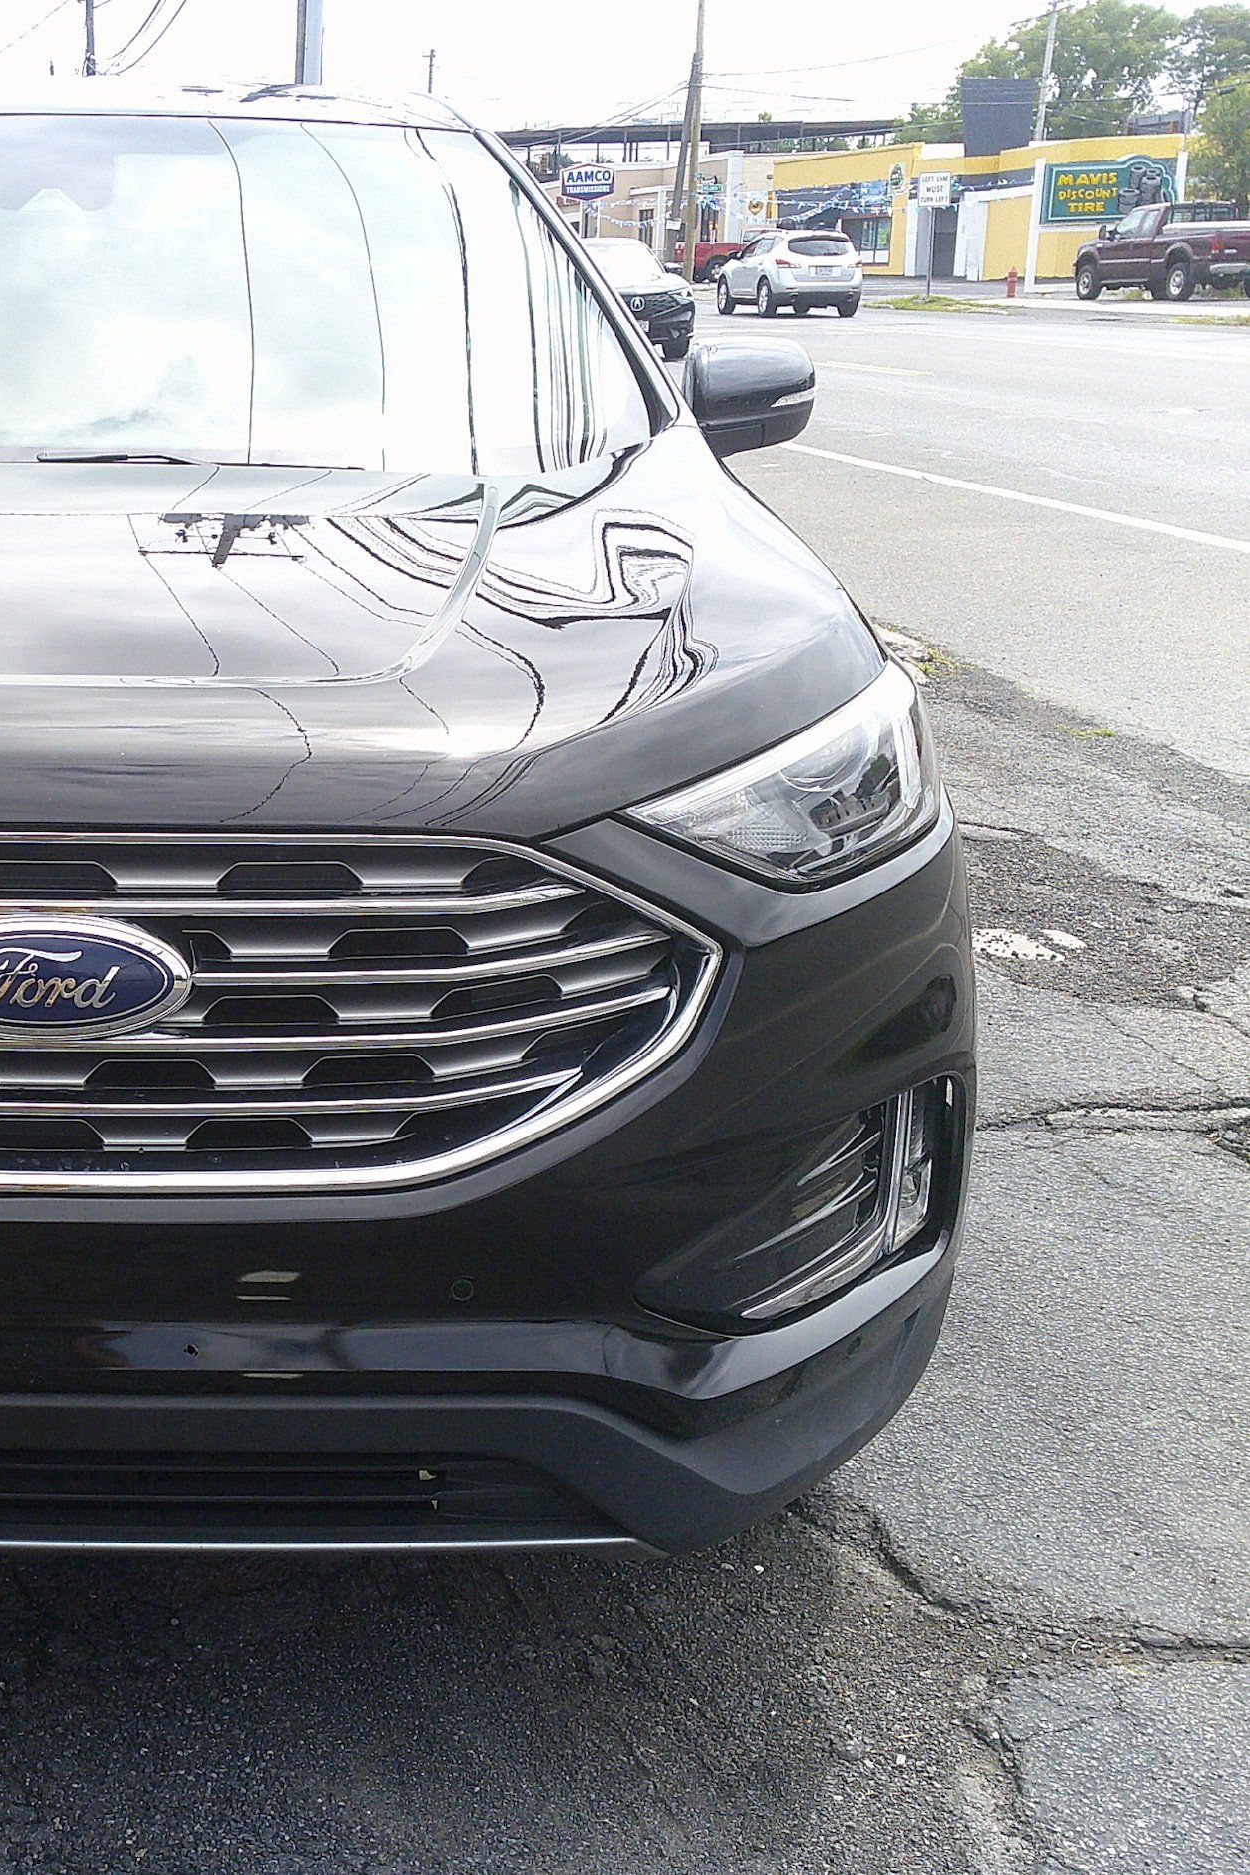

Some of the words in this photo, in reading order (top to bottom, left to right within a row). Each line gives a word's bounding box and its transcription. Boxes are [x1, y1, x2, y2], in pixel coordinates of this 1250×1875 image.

[566, 170, 611, 183] AAMCO
[1057, 172, 1118, 186] MAVIS
[926, 185, 944, 193] MUST
[1058, 187, 1119, 200] DISCOUNT
[1067, 201, 1105, 213] TIRE
